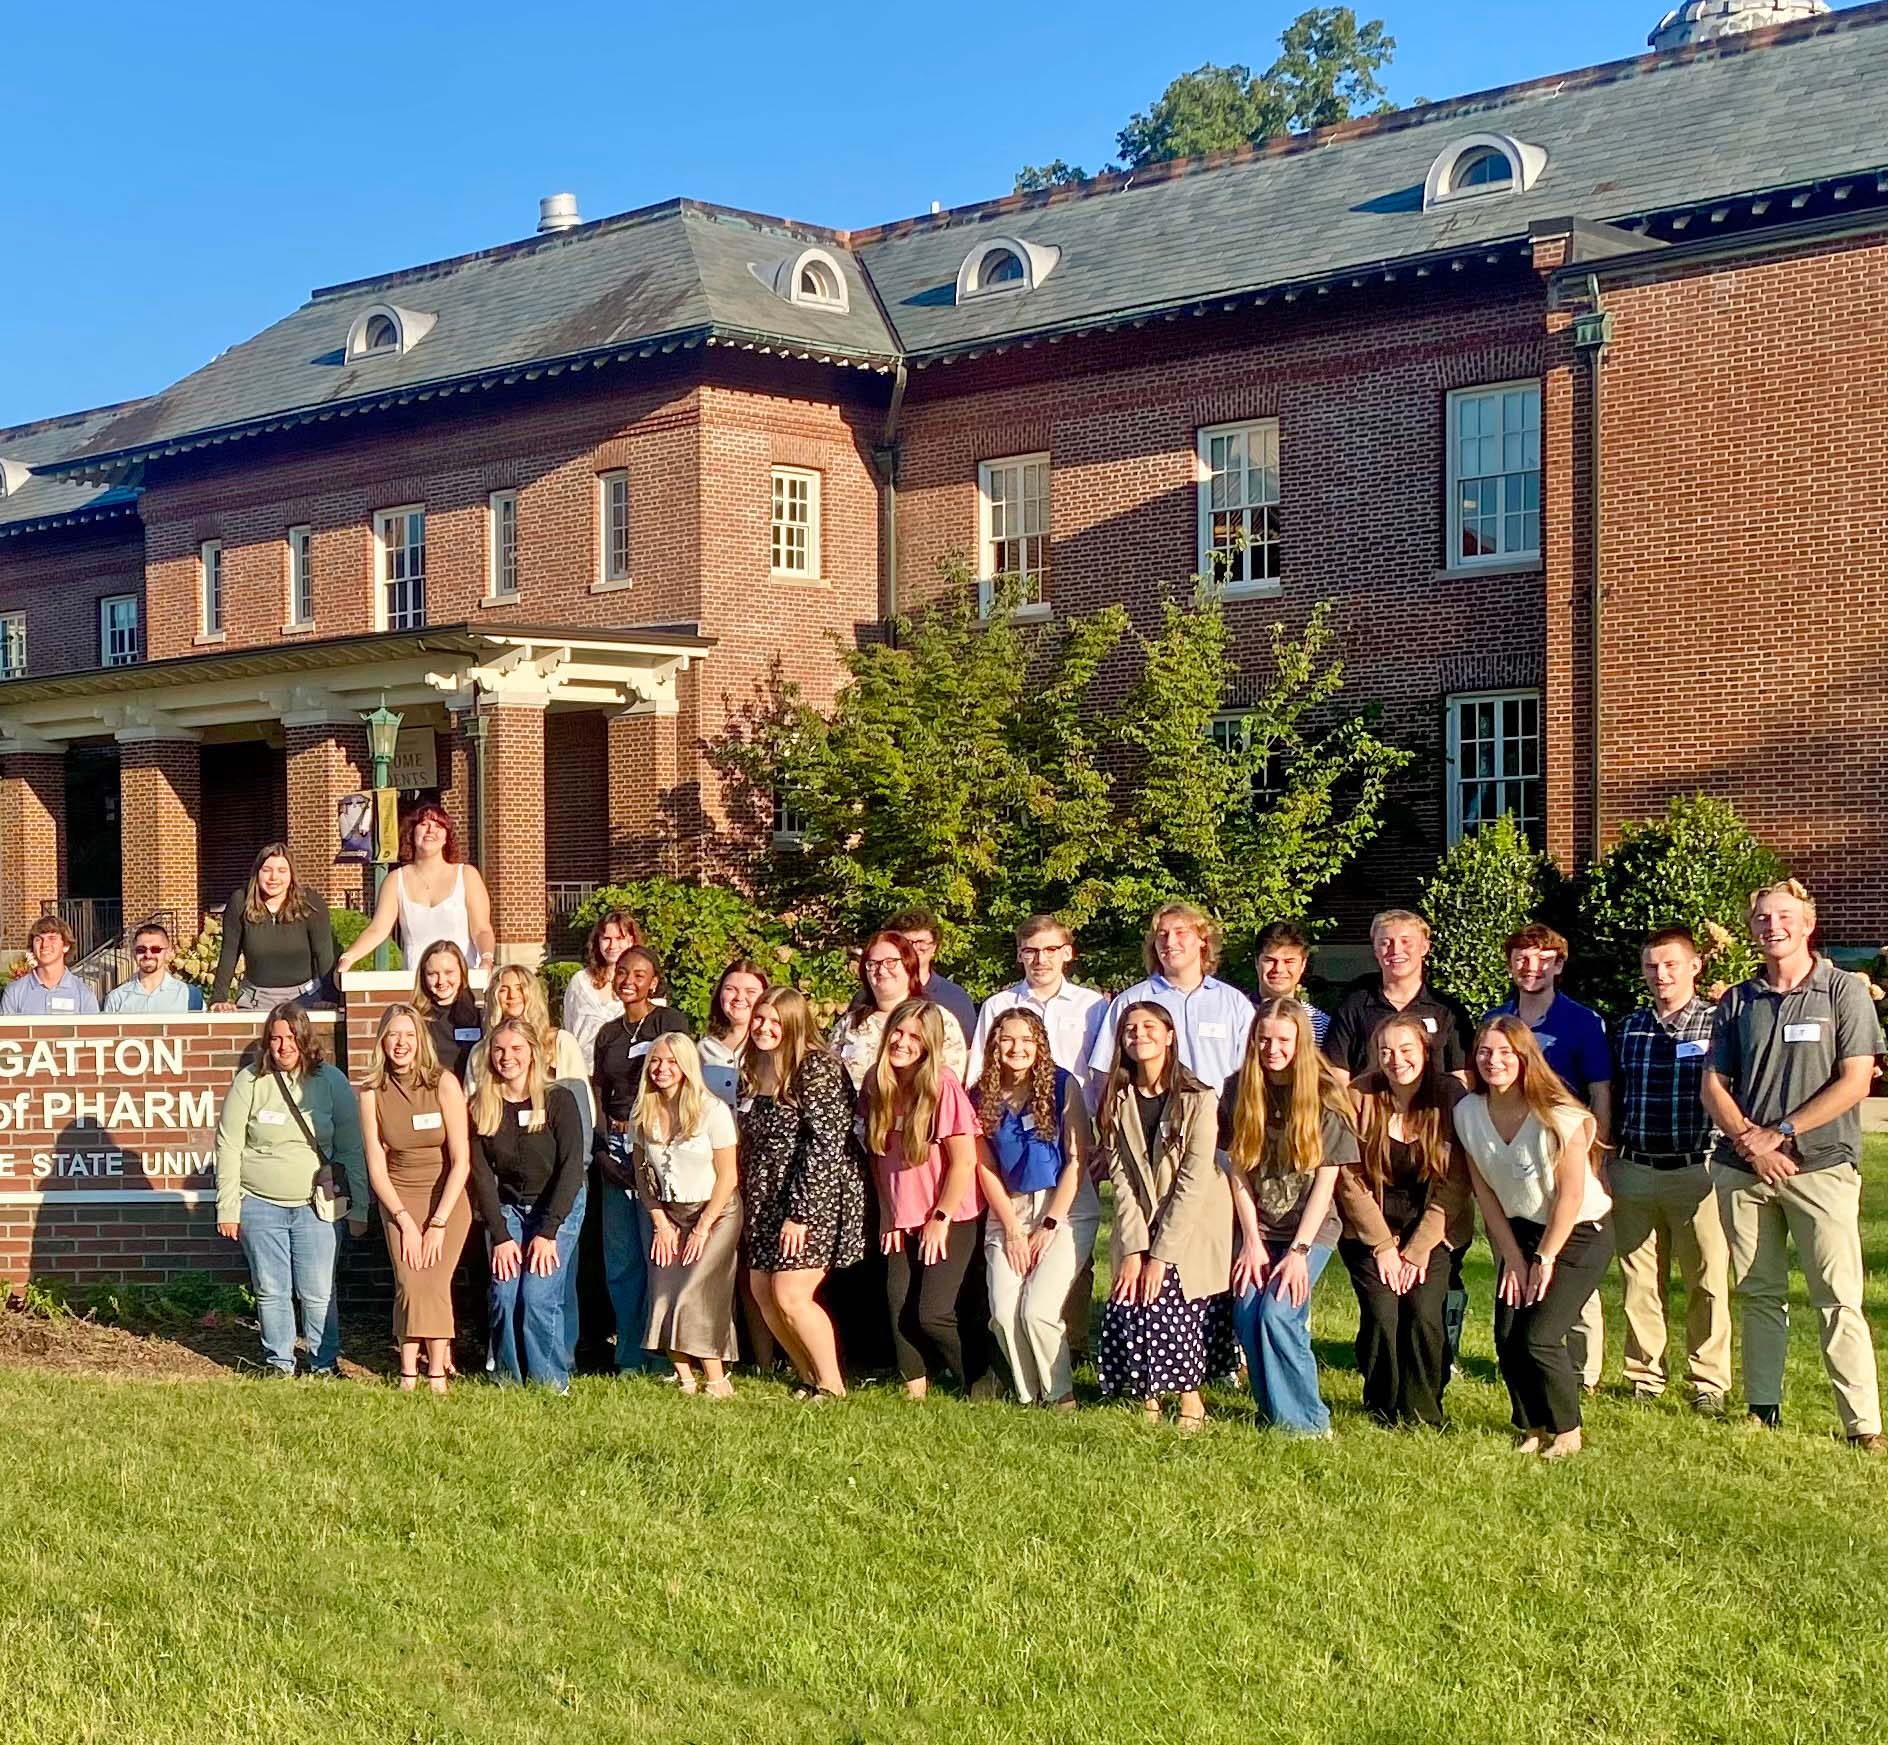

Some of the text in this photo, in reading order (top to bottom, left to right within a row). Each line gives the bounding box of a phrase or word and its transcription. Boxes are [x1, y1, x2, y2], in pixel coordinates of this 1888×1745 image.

[393, 752, 423, 768] OME
[388, 771, 428, 786] DENTS
[43, 1090, 215, 1129] PHARM
[32, 1151, 124, 1177] STATE
[142, 1151, 217, 1176] UNIV
